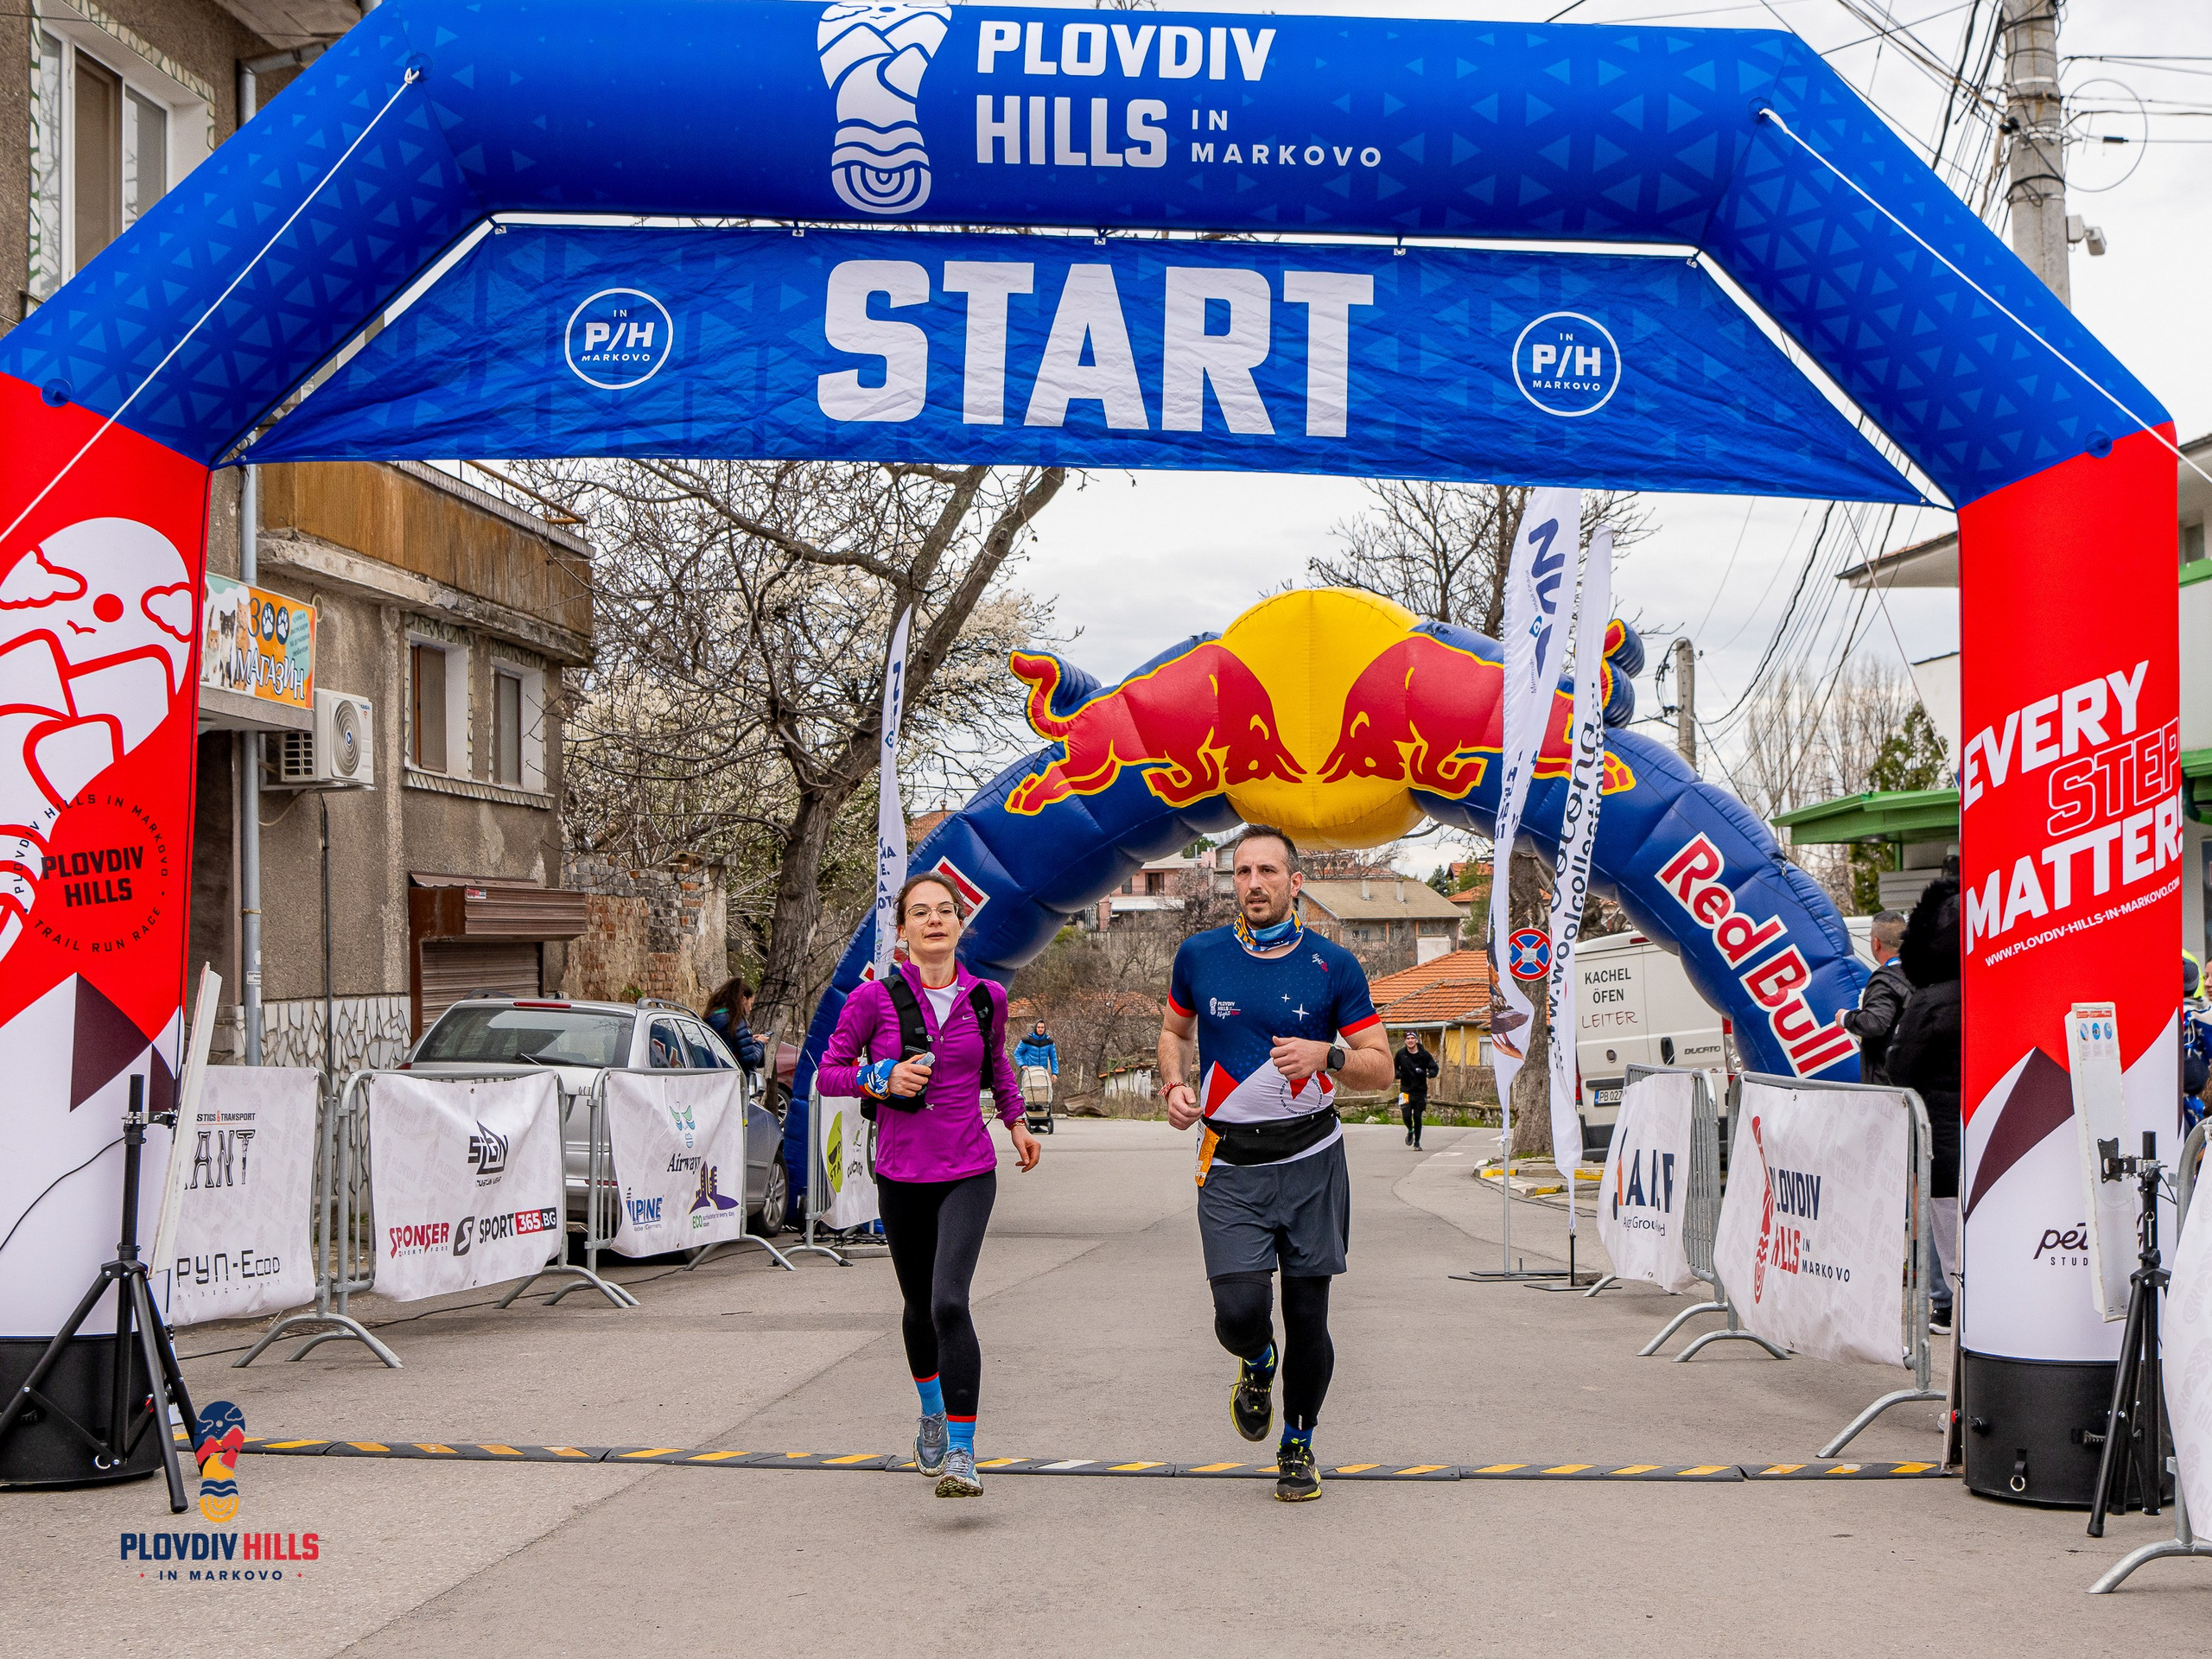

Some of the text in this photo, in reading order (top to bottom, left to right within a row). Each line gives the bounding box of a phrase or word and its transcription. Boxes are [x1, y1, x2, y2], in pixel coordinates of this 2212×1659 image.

[977, 21, 1276, 81] PLOVDIV
[976, 95, 1167, 168] HILLS
[1192, 110, 1227, 130] IN
[1192, 143, 1382, 168] MARKOVO
[613, 309, 627, 318] IN
[584, 322, 654, 351] P/H
[817, 260, 1374, 438] START
[581, 353, 652, 363] MARKOVO
[1533, 344, 1601, 378] P/H
[1533, 380, 1601, 391] MARKOVO
[236, 648, 305, 700] МАГАЗИН
[1964, 660, 2149, 811] EVERY
[2047, 716, 2180, 836] STEP
[13, 794, 168, 895] PLOVDIV HILLS IN MARKOVO
[41, 845, 144, 880] PLOVDIV
[64, 877, 133, 907] HILLS
[34, 906, 162, 953] TRAIL RUN RACE
[1985, 875, 2180, 968] WWW.PLOVDIV-HILLS-IN-MARKOVO.COM
[1657, 833, 1858, 1077] Red Bull
[1585, 968, 1631, 984] KACHEL
[1592, 988, 1624, 1003] ÖFEN
[1582, 1011, 1638, 1029] LEITER
[1684, 1046, 1721, 1055] DUCATO
[1599, 1090, 1623, 1102] PB 027
[196, 1113, 216, 1122] STICS
[220, 1112, 256, 1122] TRANSPORT
[184, 1129, 256, 1191] ANT
[1769, 1166, 1821, 1221] OVDIV
[389, 1222, 450, 1260] SPONSER
[1802, 1237, 1810, 1252] IN
[1802, 1259, 1851, 1283] MARKOVO
[2050, 1257, 2088, 1266] STUD
